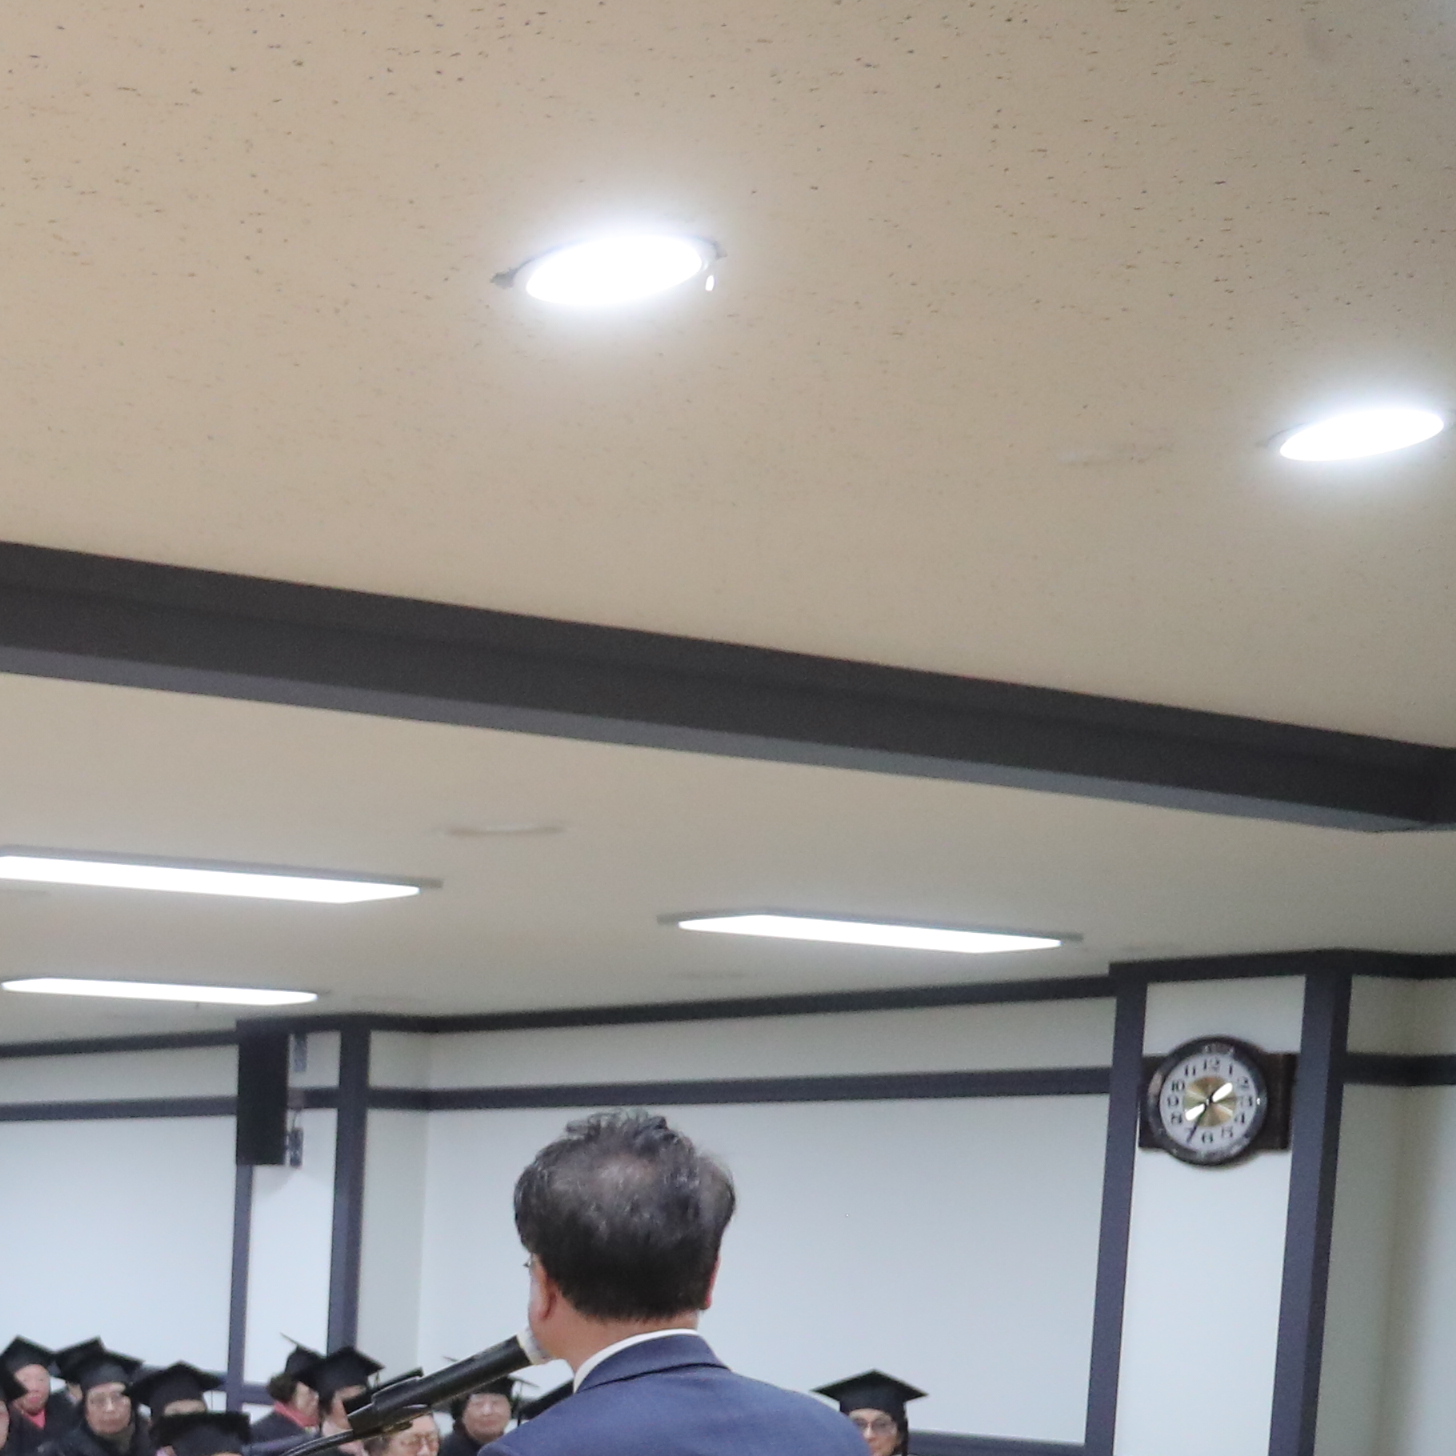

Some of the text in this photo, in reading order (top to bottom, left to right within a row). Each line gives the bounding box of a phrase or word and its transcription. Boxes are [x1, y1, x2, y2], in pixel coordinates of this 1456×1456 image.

[1184, 1063, 1196, 1076] 11
[1203, 1057, 1221, 1071] 12
[1228, 1062, 1234, 1075] 1
[1171, 1079, 1185, 1092] 10
[1237, 1076, 1250, 1089] 2
[1167, 1095, 1179, 1108] 9
[1234, 1111, 1246, 1124] 4
[1201, 1131, 1214, 1144] 6
